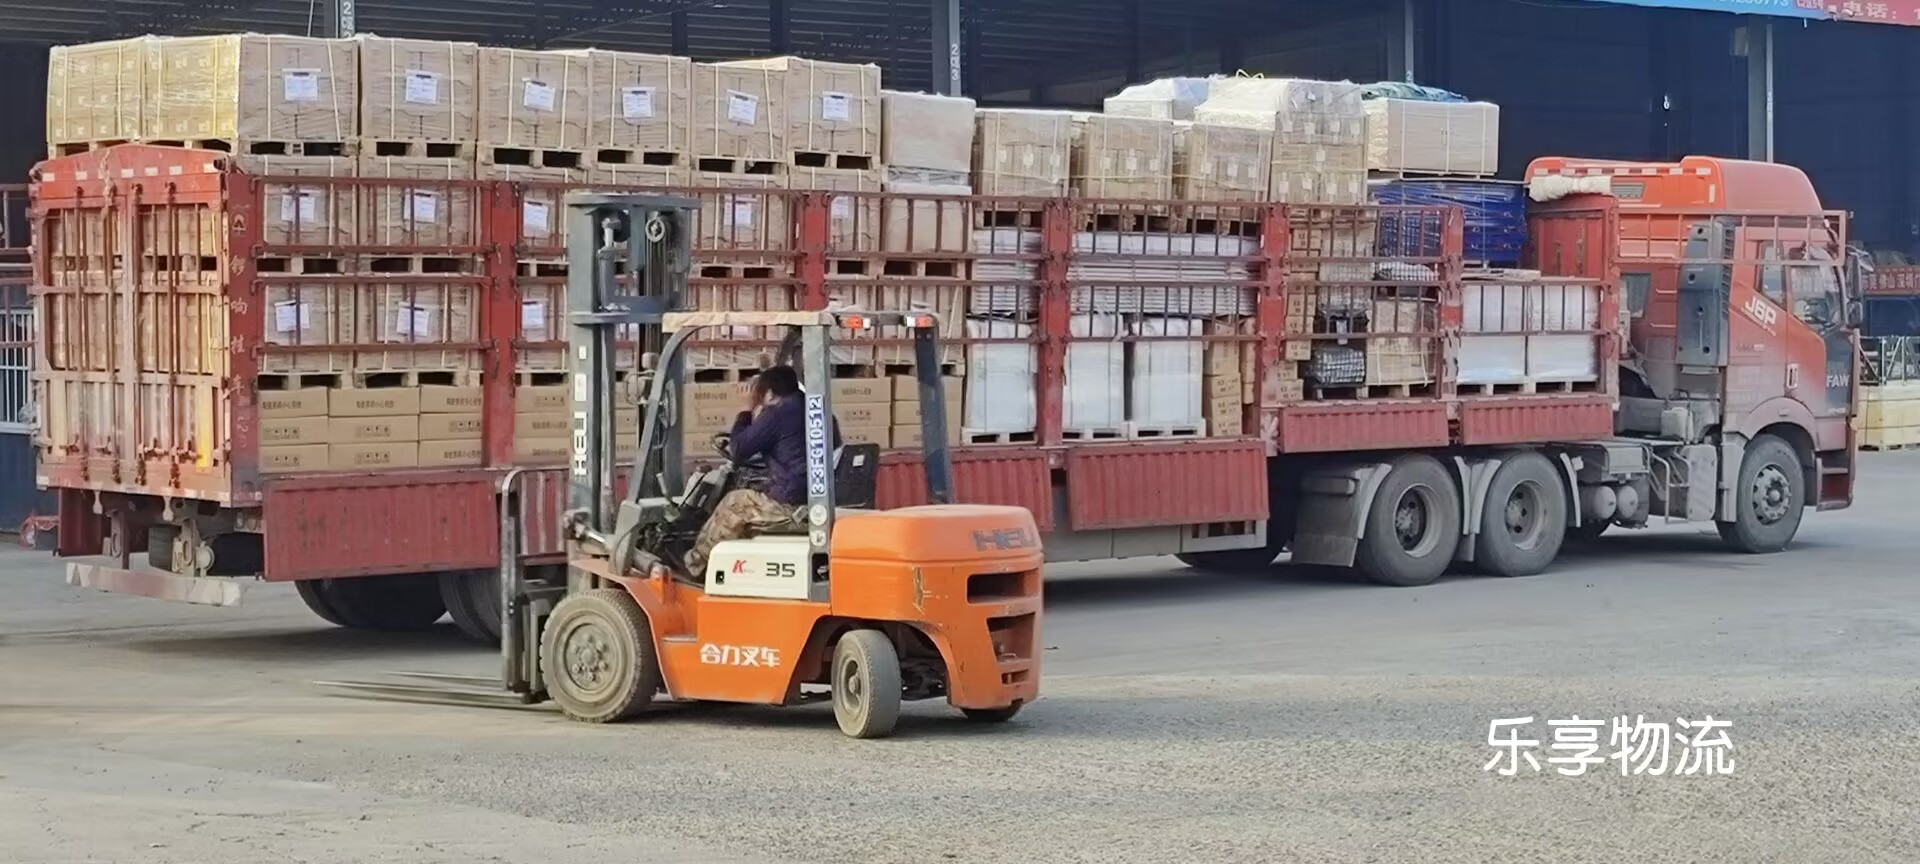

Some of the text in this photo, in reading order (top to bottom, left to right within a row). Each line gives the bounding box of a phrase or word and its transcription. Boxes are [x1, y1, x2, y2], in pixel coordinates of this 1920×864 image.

[1826, 374, 1850, 388] FAW
[573, 411, 588, 476] HELI
[766, 562, 796, 578] 35
[700, 643, 780, 667] 合力叉车
